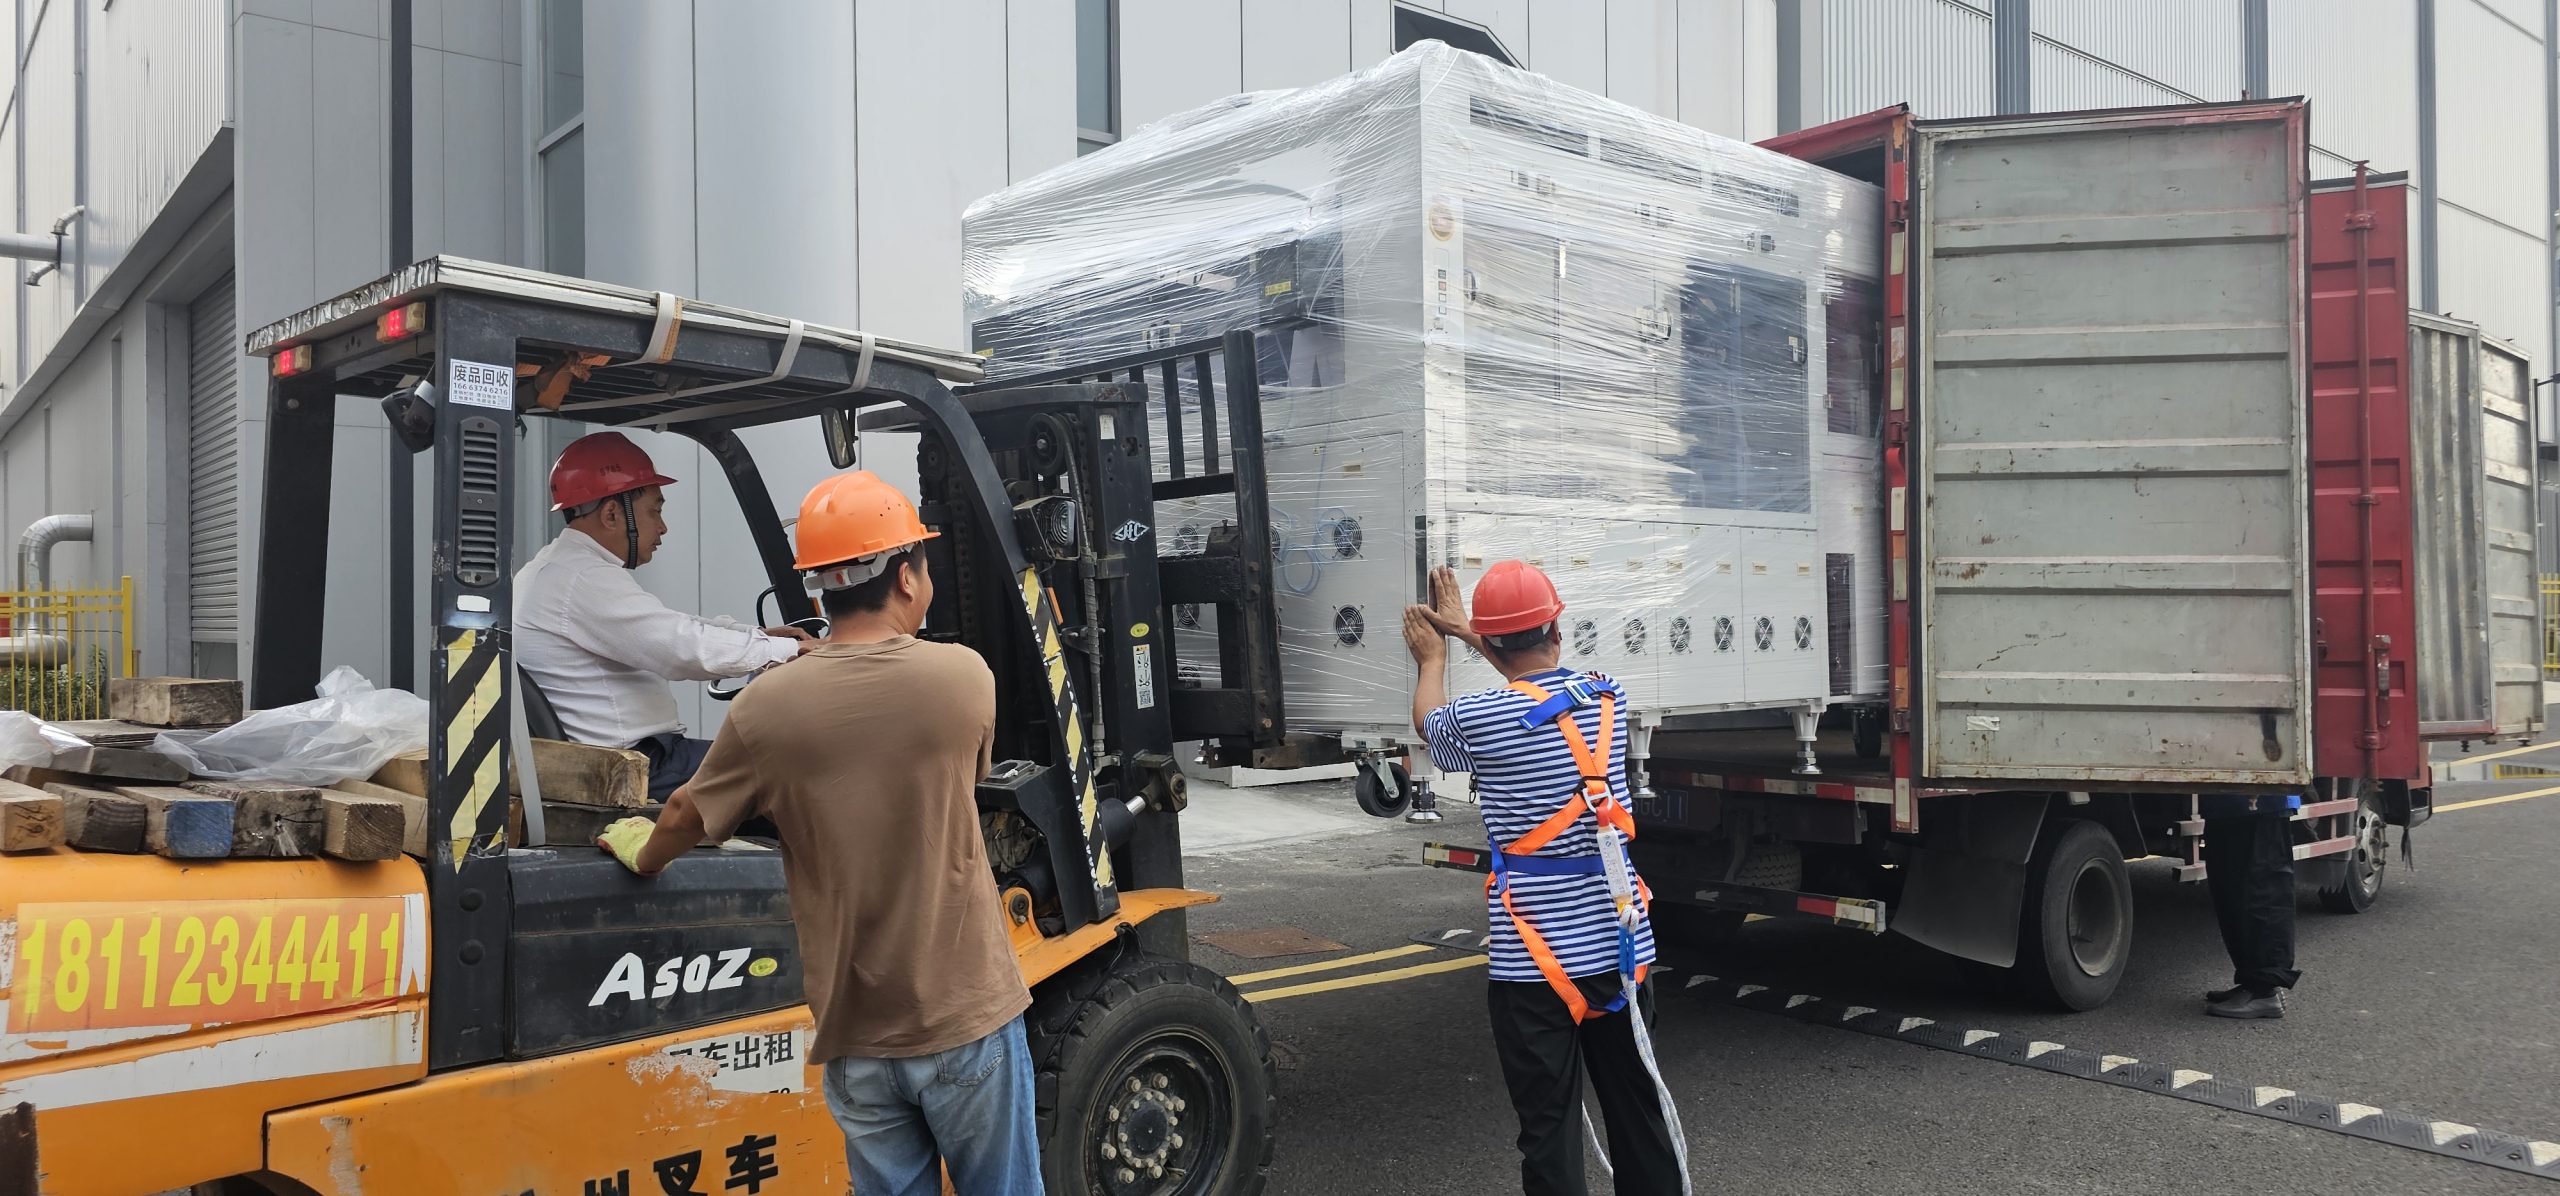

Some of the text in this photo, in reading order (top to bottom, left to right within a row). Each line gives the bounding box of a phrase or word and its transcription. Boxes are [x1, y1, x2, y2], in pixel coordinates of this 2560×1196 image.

[453, 364, 509, 387] 废品回收
[20, 912, 400, 1014] 18112344411
